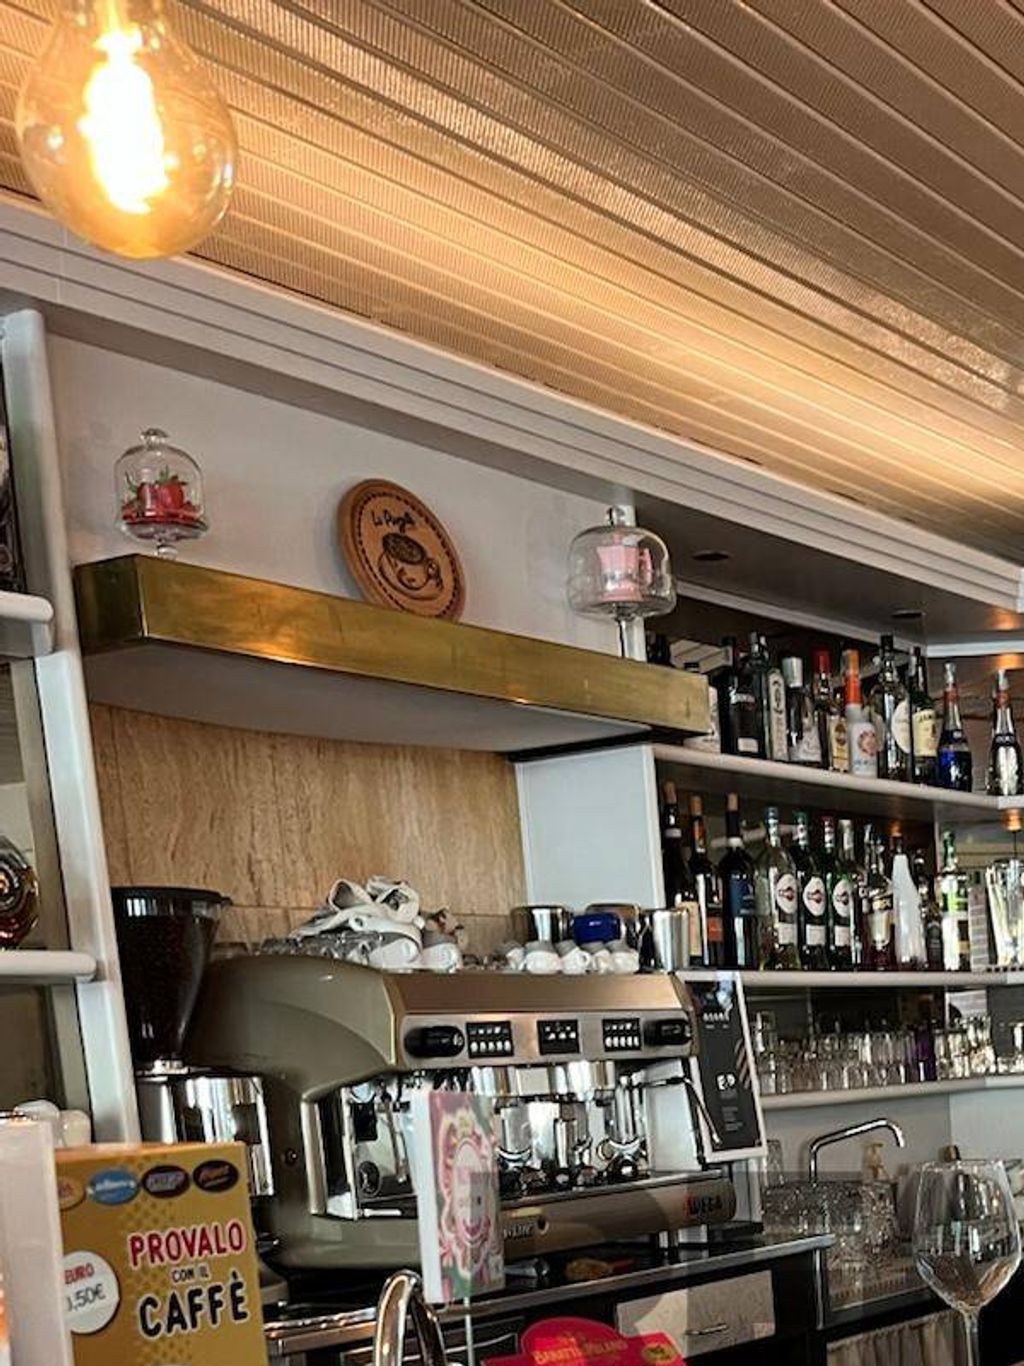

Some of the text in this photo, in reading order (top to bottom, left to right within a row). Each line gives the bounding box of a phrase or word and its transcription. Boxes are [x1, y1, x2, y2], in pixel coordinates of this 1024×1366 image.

[128, 1220, 246, 1269] PROVALO
[64, 1262, 95, 1284] EURO
[172, 1263, 211, 1284] CON IL
[137, 1270, 249, 1338] CAFFÈ
